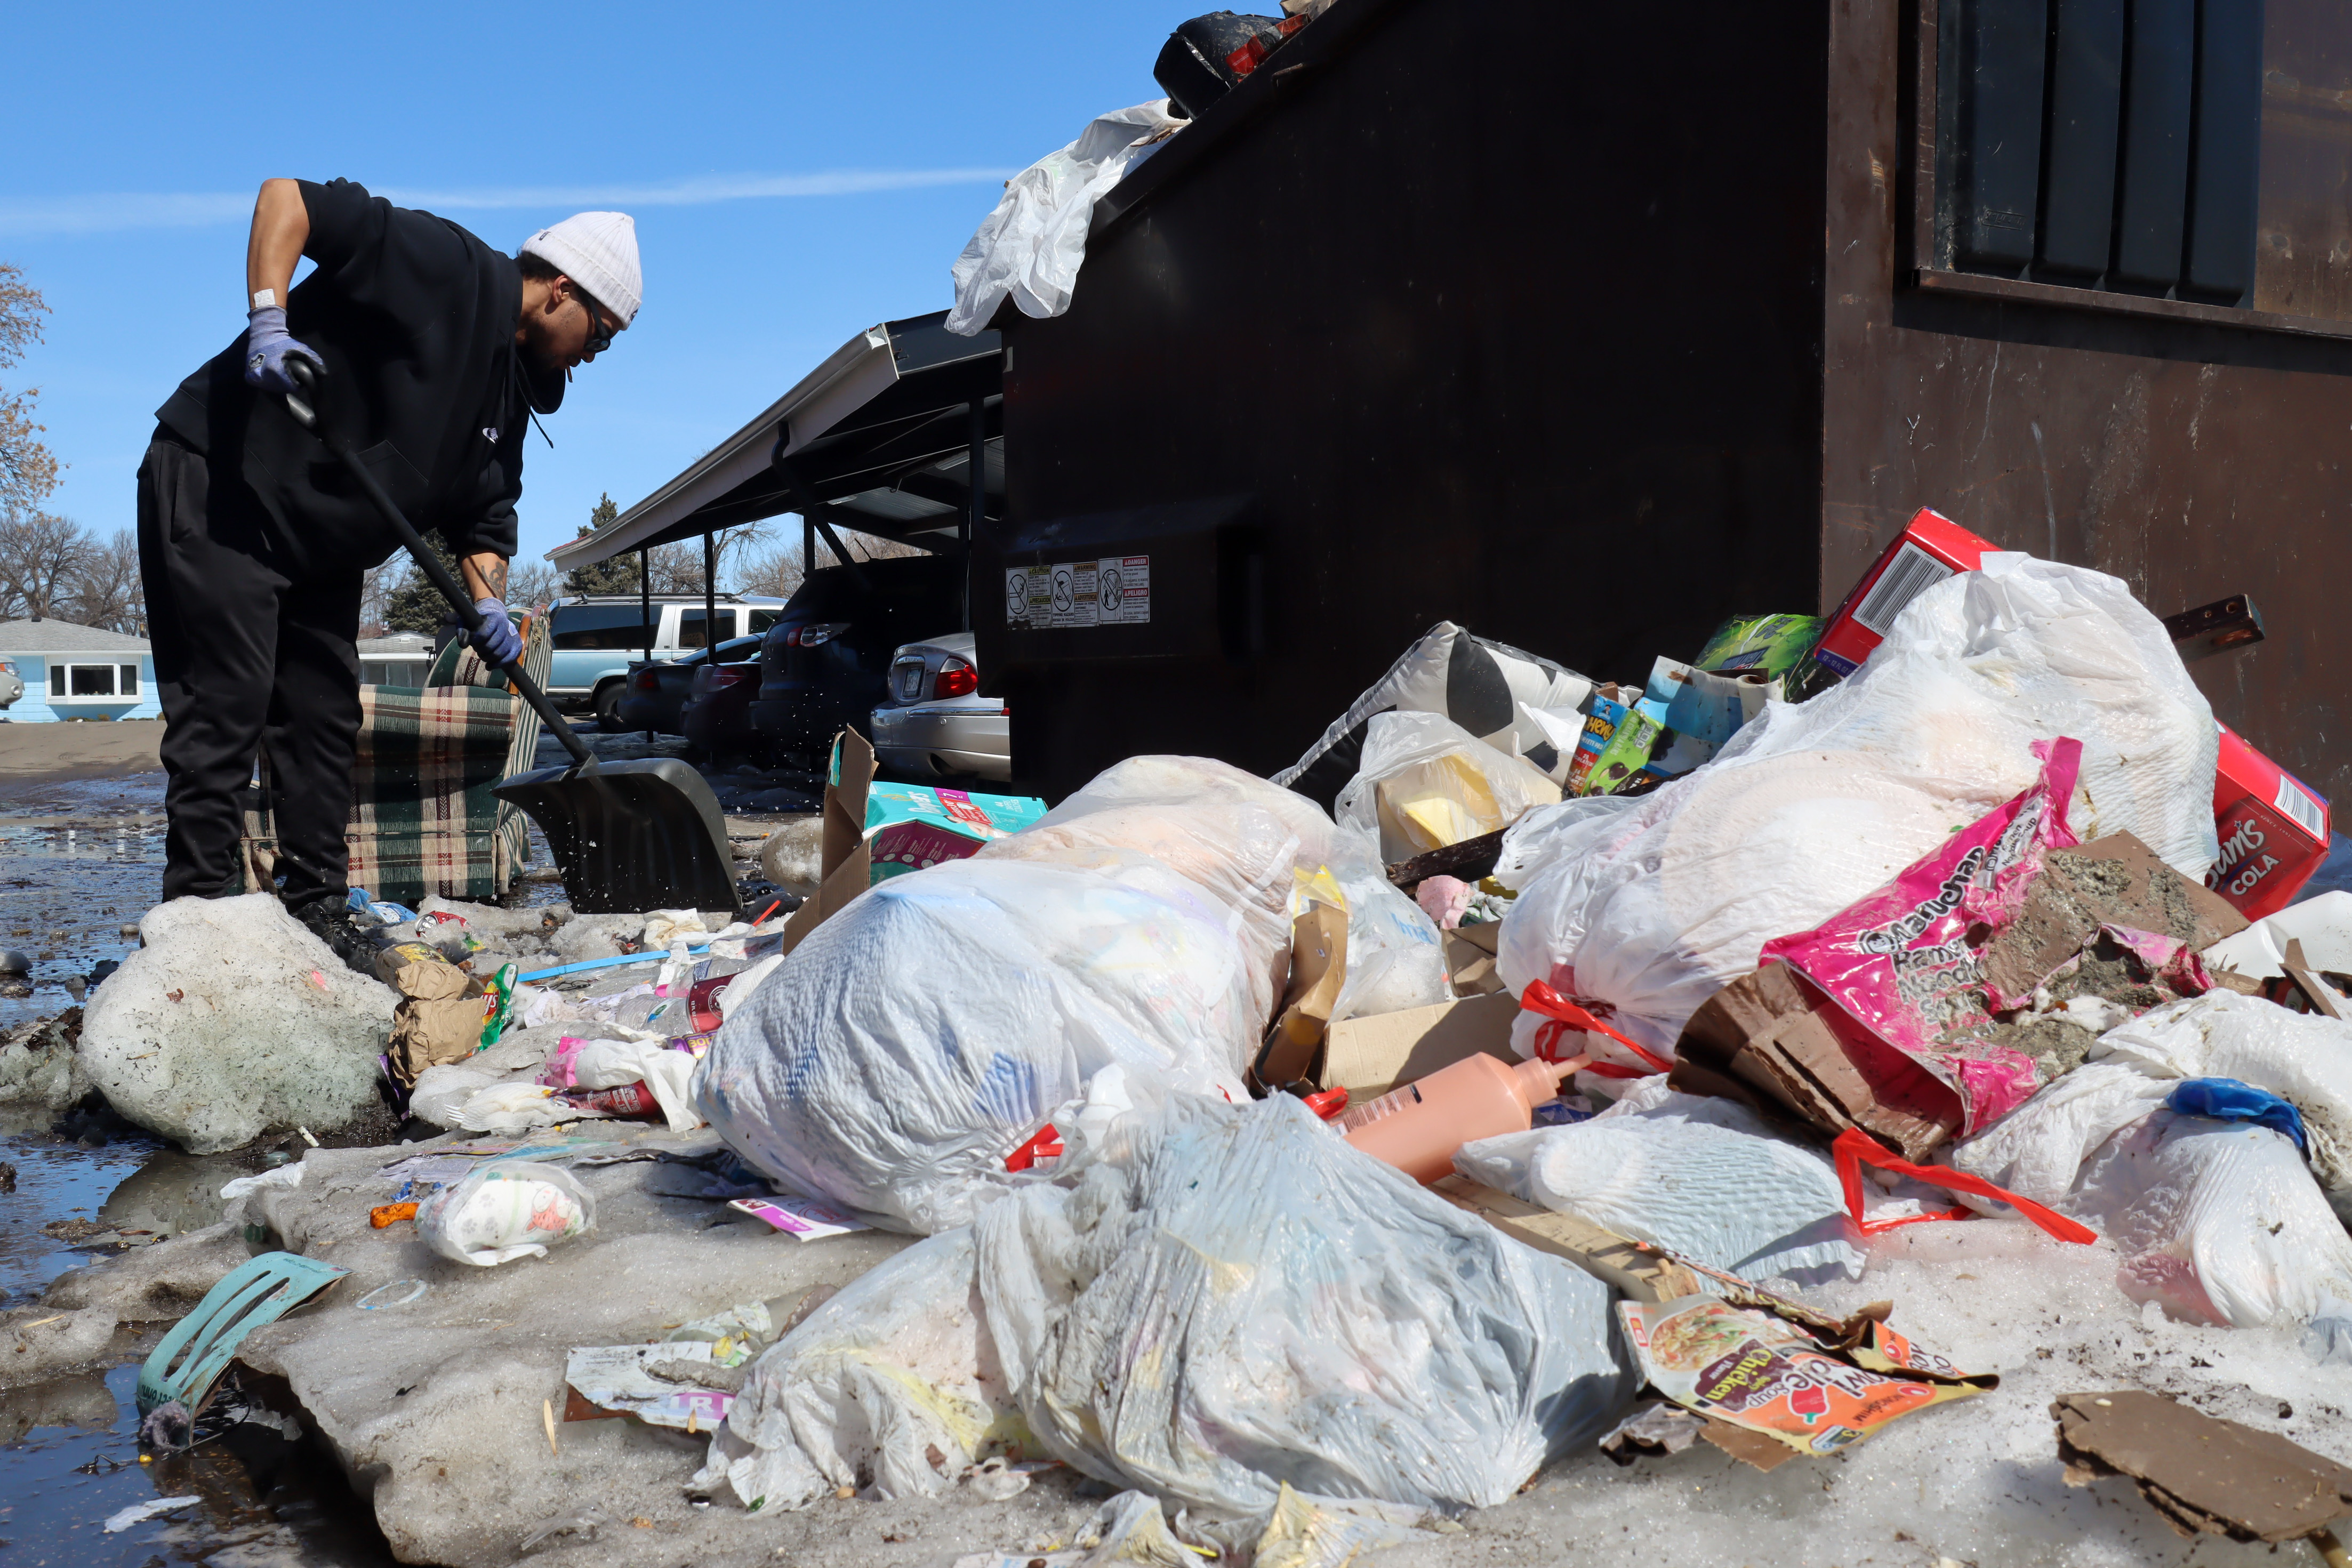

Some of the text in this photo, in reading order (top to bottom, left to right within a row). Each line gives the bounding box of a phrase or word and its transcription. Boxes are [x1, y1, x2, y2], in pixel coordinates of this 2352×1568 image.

[2230, 854, 2280, 896] COLA
[1888, 848, 1984, 945] Maruchan
[619, 1104, 628, 1113] 150
[1705, 1348, 1773, 1401] Chicken
[1708, 1361, 1735, 1380] Flavor
[1748, 1375, 1772, 1389] Spicy
[1748, 1383, 1790, 1408] Soup
[1852, 1394, 1906, 1424] NONGSHIM
